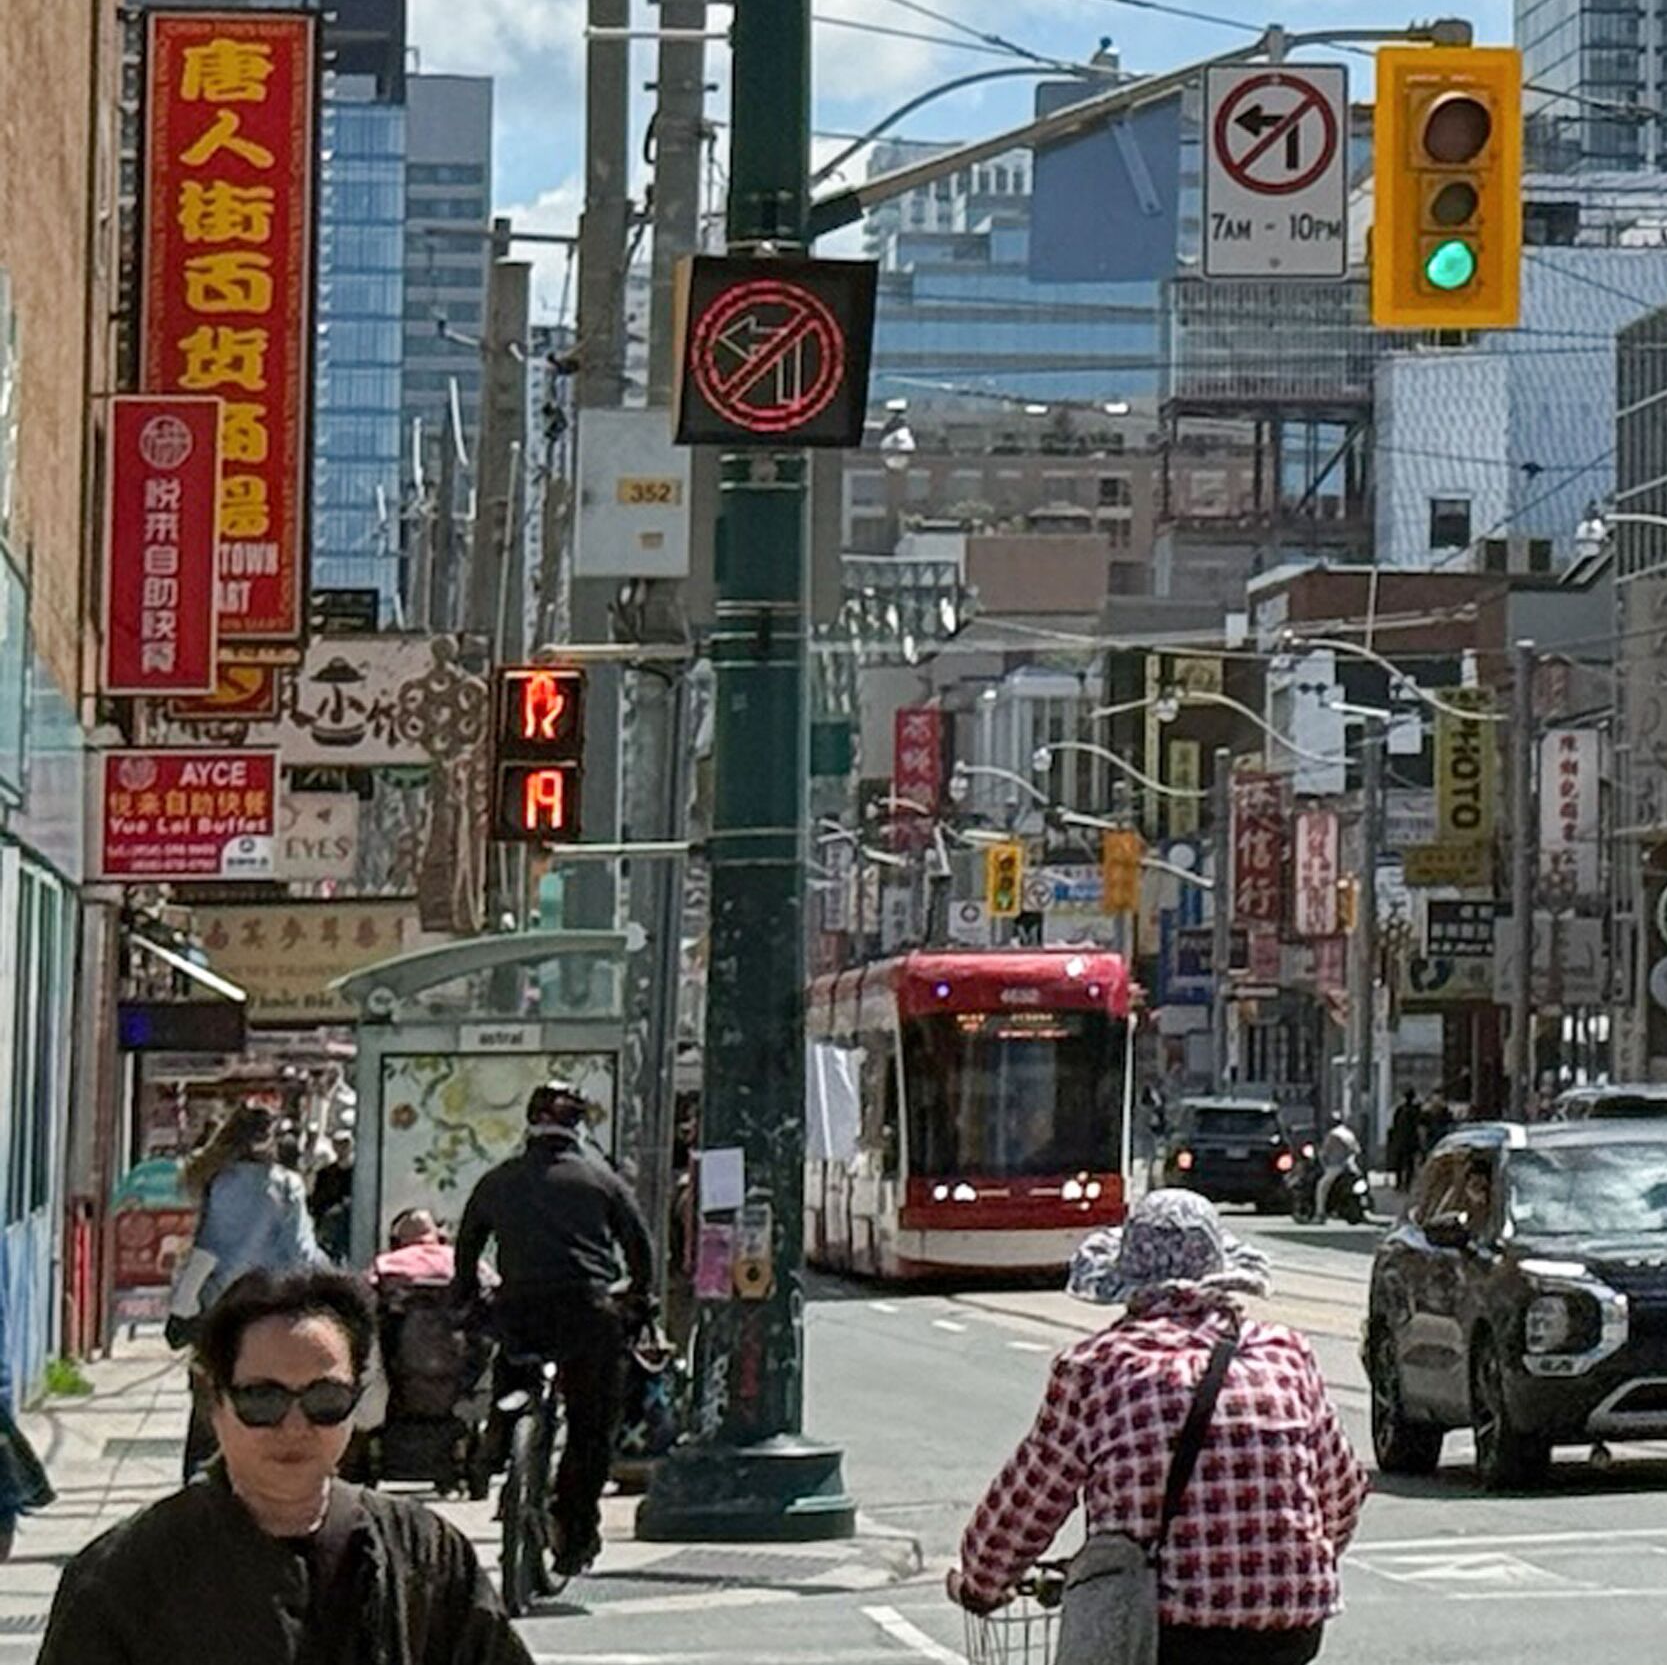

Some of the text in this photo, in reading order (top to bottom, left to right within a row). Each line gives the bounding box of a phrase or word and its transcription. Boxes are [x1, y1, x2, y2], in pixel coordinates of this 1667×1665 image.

[1211, 213, 1252, 242] 7AM
[1289, 213, 1343, 242] 10PM
[629, 482, 672, 504] 352
[179, 761, 248, 787] AYCE
[1451, 717, 1482, 830] PHOTO
[110, 817, 150, 835] Yue
[285, 837, 349, 860] EYES
